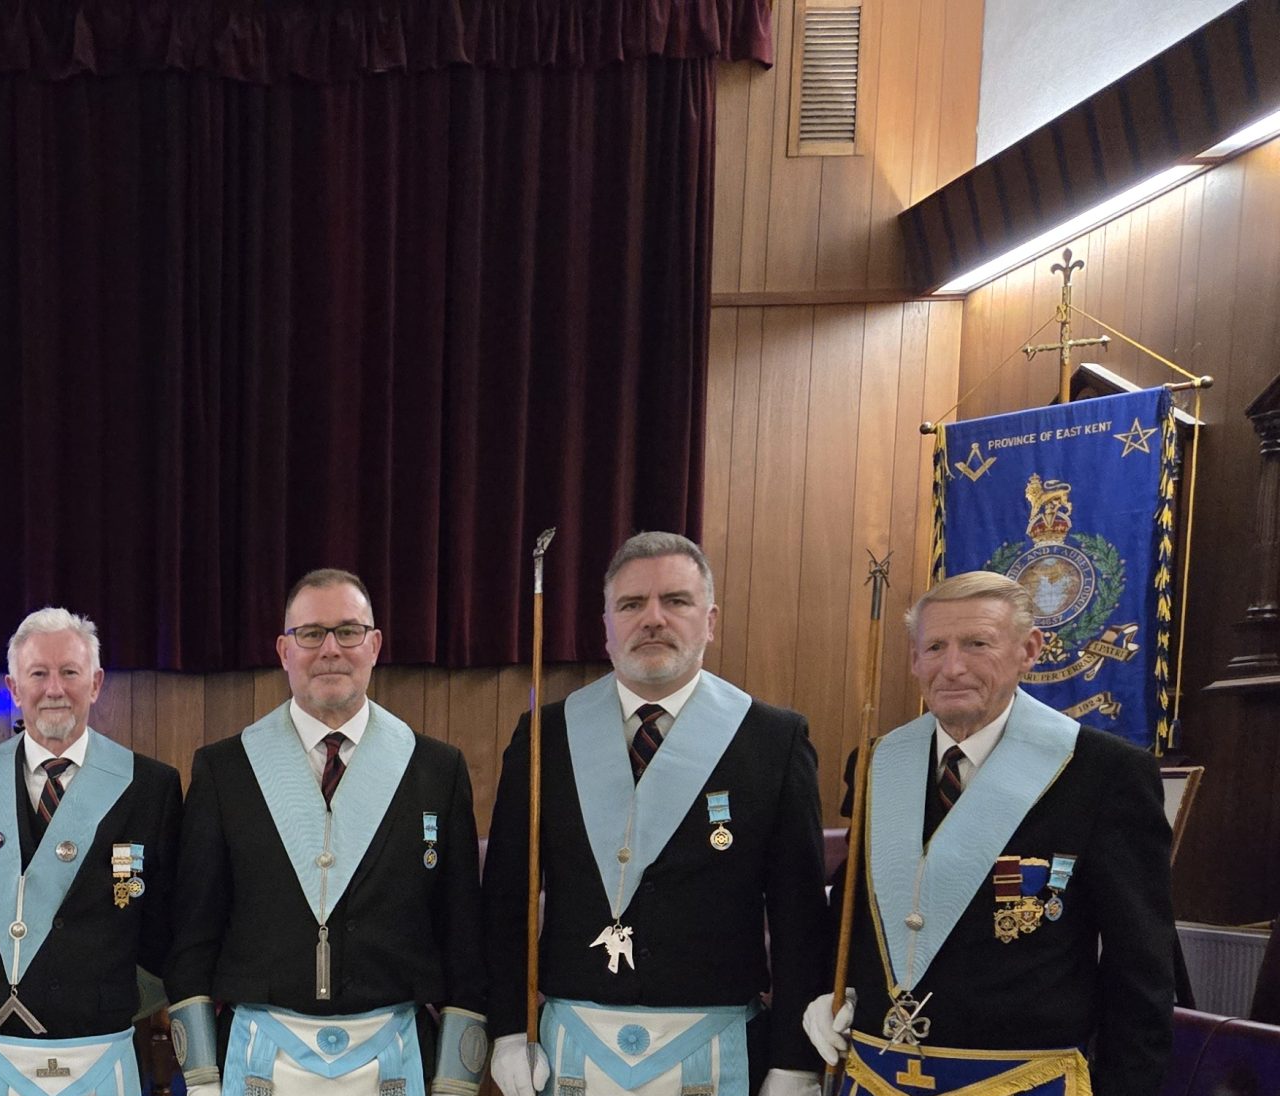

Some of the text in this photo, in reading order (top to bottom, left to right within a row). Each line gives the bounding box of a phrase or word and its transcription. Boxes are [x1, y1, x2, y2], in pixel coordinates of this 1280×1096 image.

[988, 421, 1113, 451] PROVINCE OF EAST KENT
[1026, 547, 1050, 561] AND
